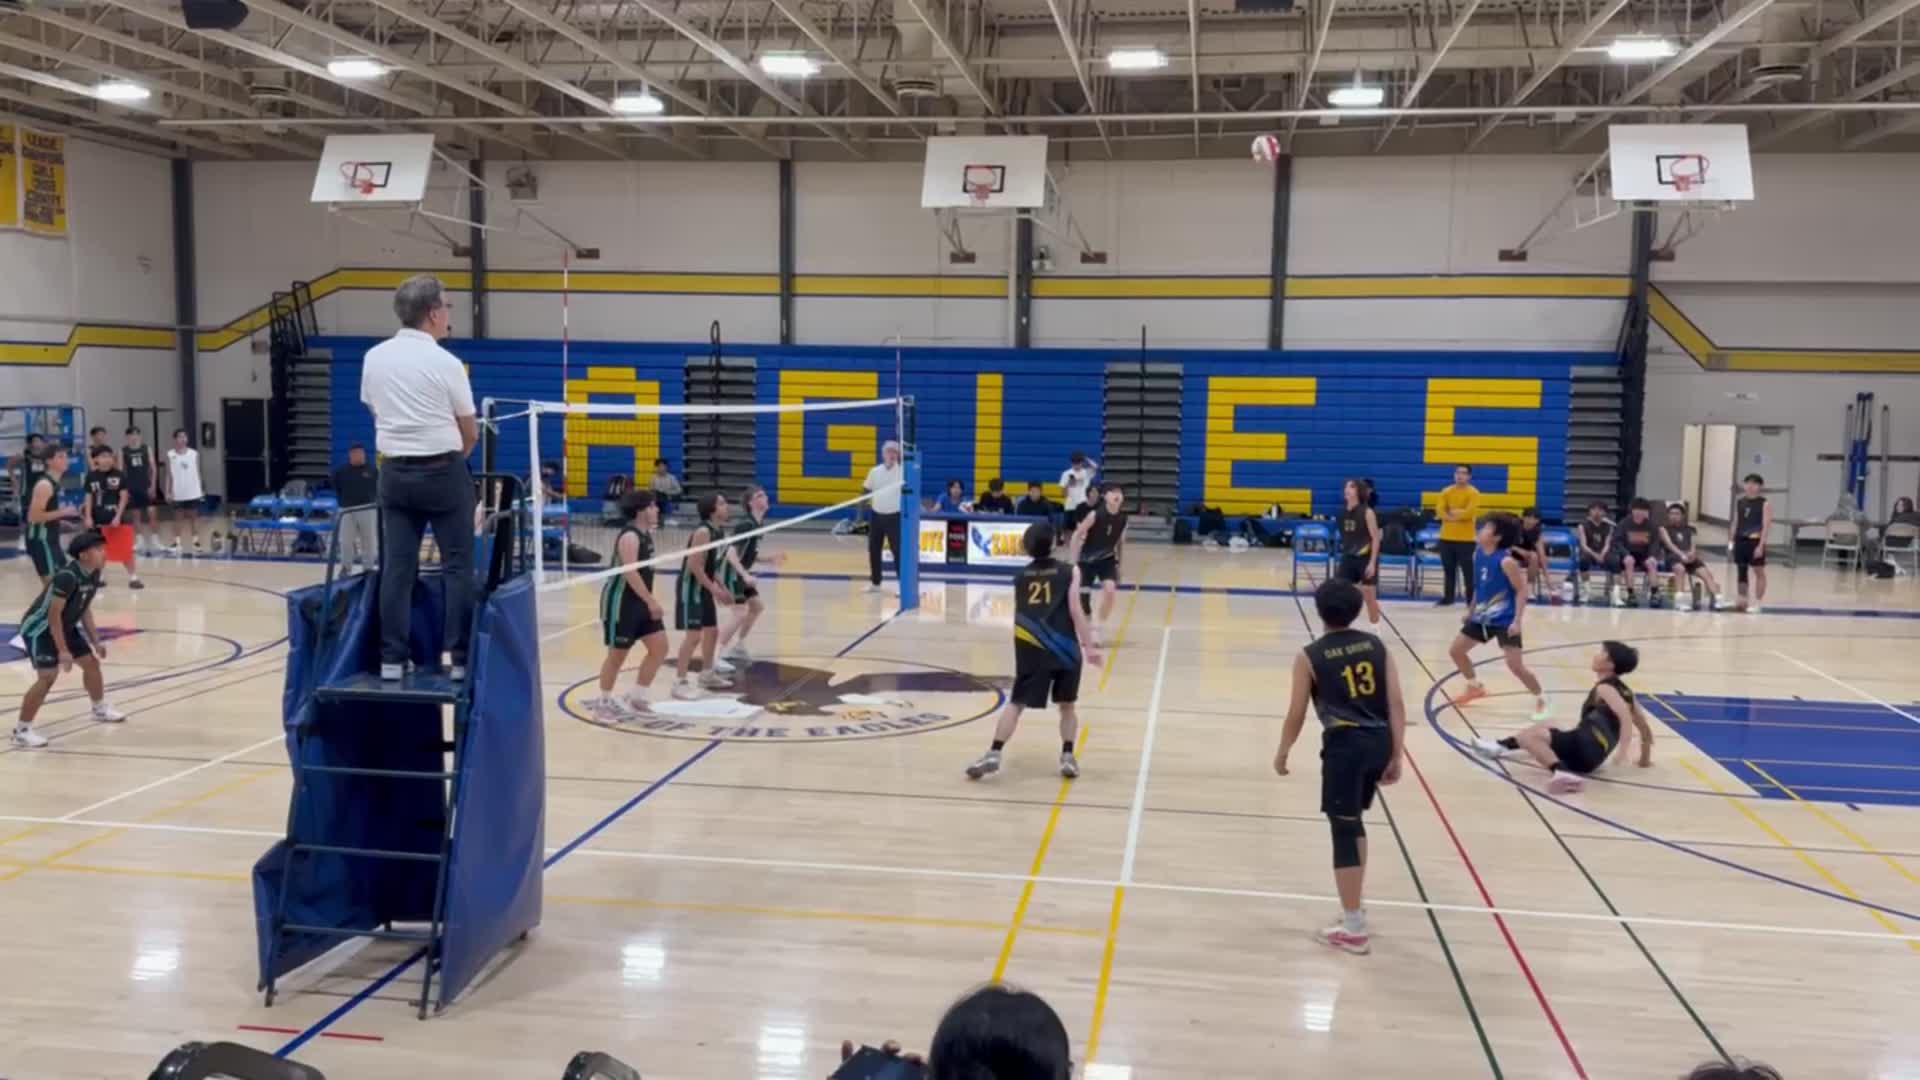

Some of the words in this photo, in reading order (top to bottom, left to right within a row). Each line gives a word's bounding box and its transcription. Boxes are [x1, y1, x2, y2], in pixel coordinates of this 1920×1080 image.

[1028, 581, 1051, 605] 21
[1341, 661, 1377, 699] 13
[708, 726, 788, 738] THE
[806, 712, 951, 737] EAGLES
